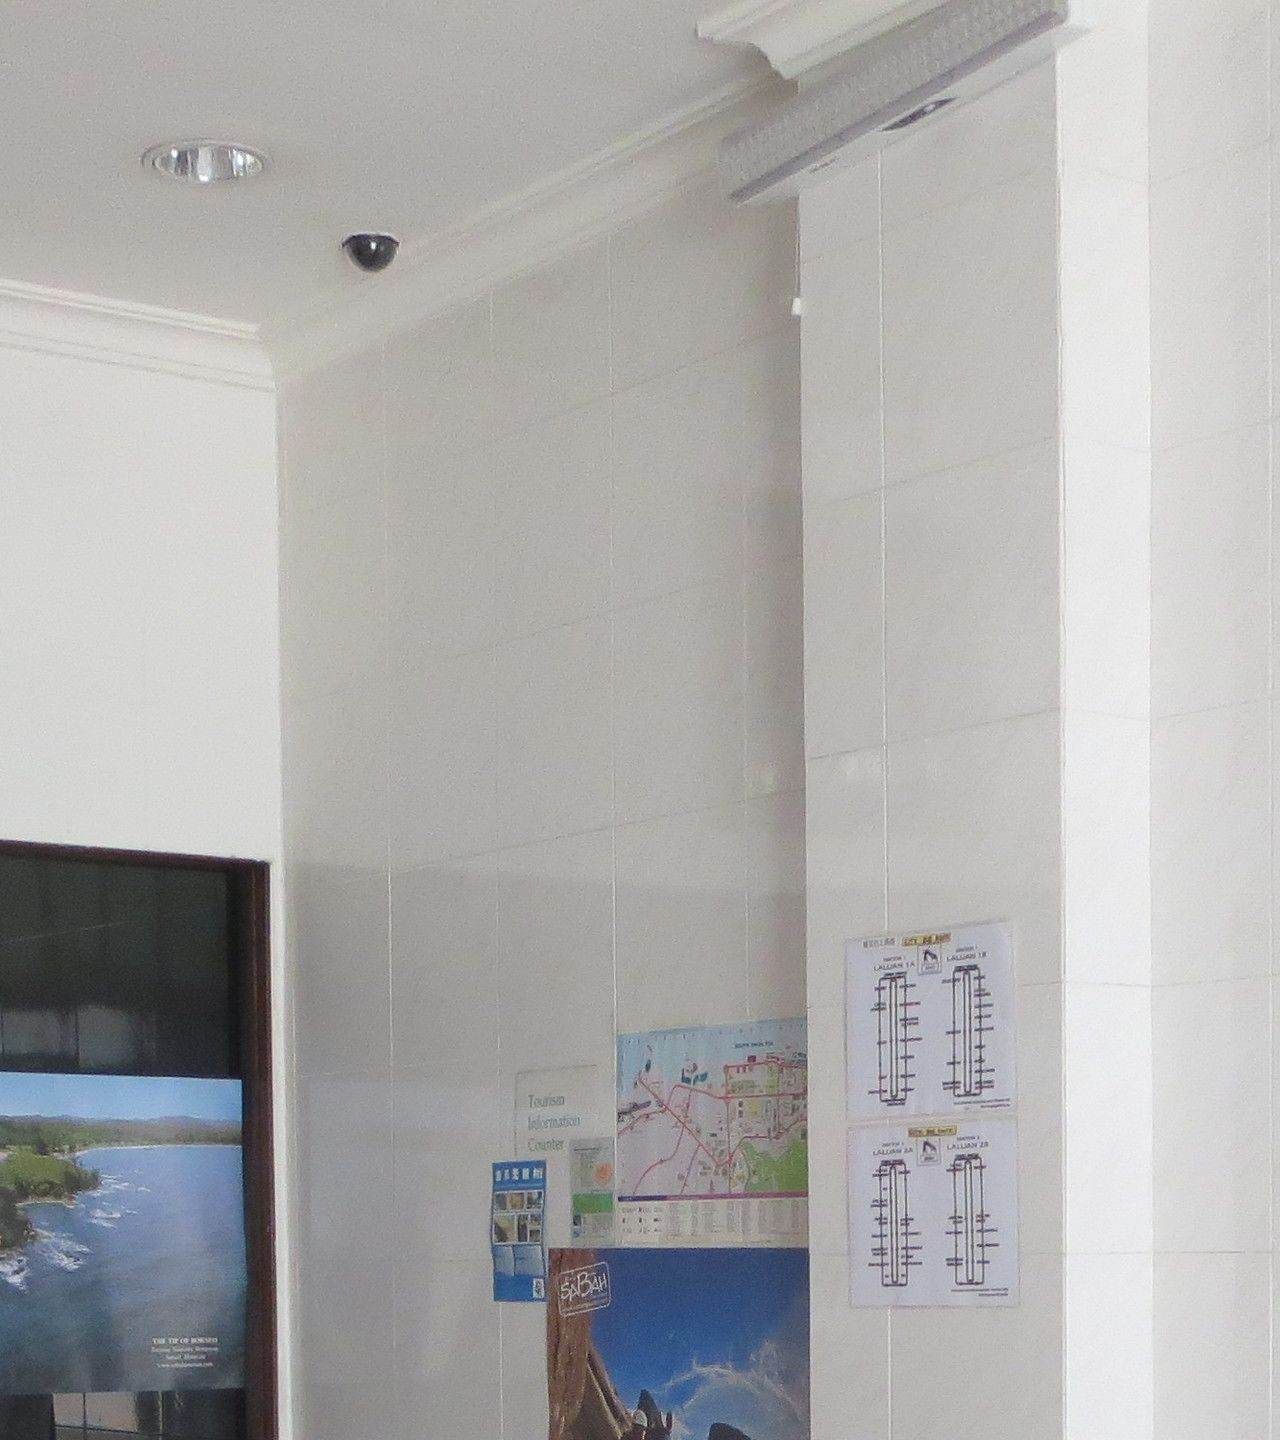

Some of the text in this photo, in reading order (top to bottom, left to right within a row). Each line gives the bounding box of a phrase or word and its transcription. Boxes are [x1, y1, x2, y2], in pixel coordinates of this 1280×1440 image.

[528, 1094, 565, 1108] Tourism
[527, 1115, 581, 1130] Information
[527, 1138, 565, 1151] Counter
